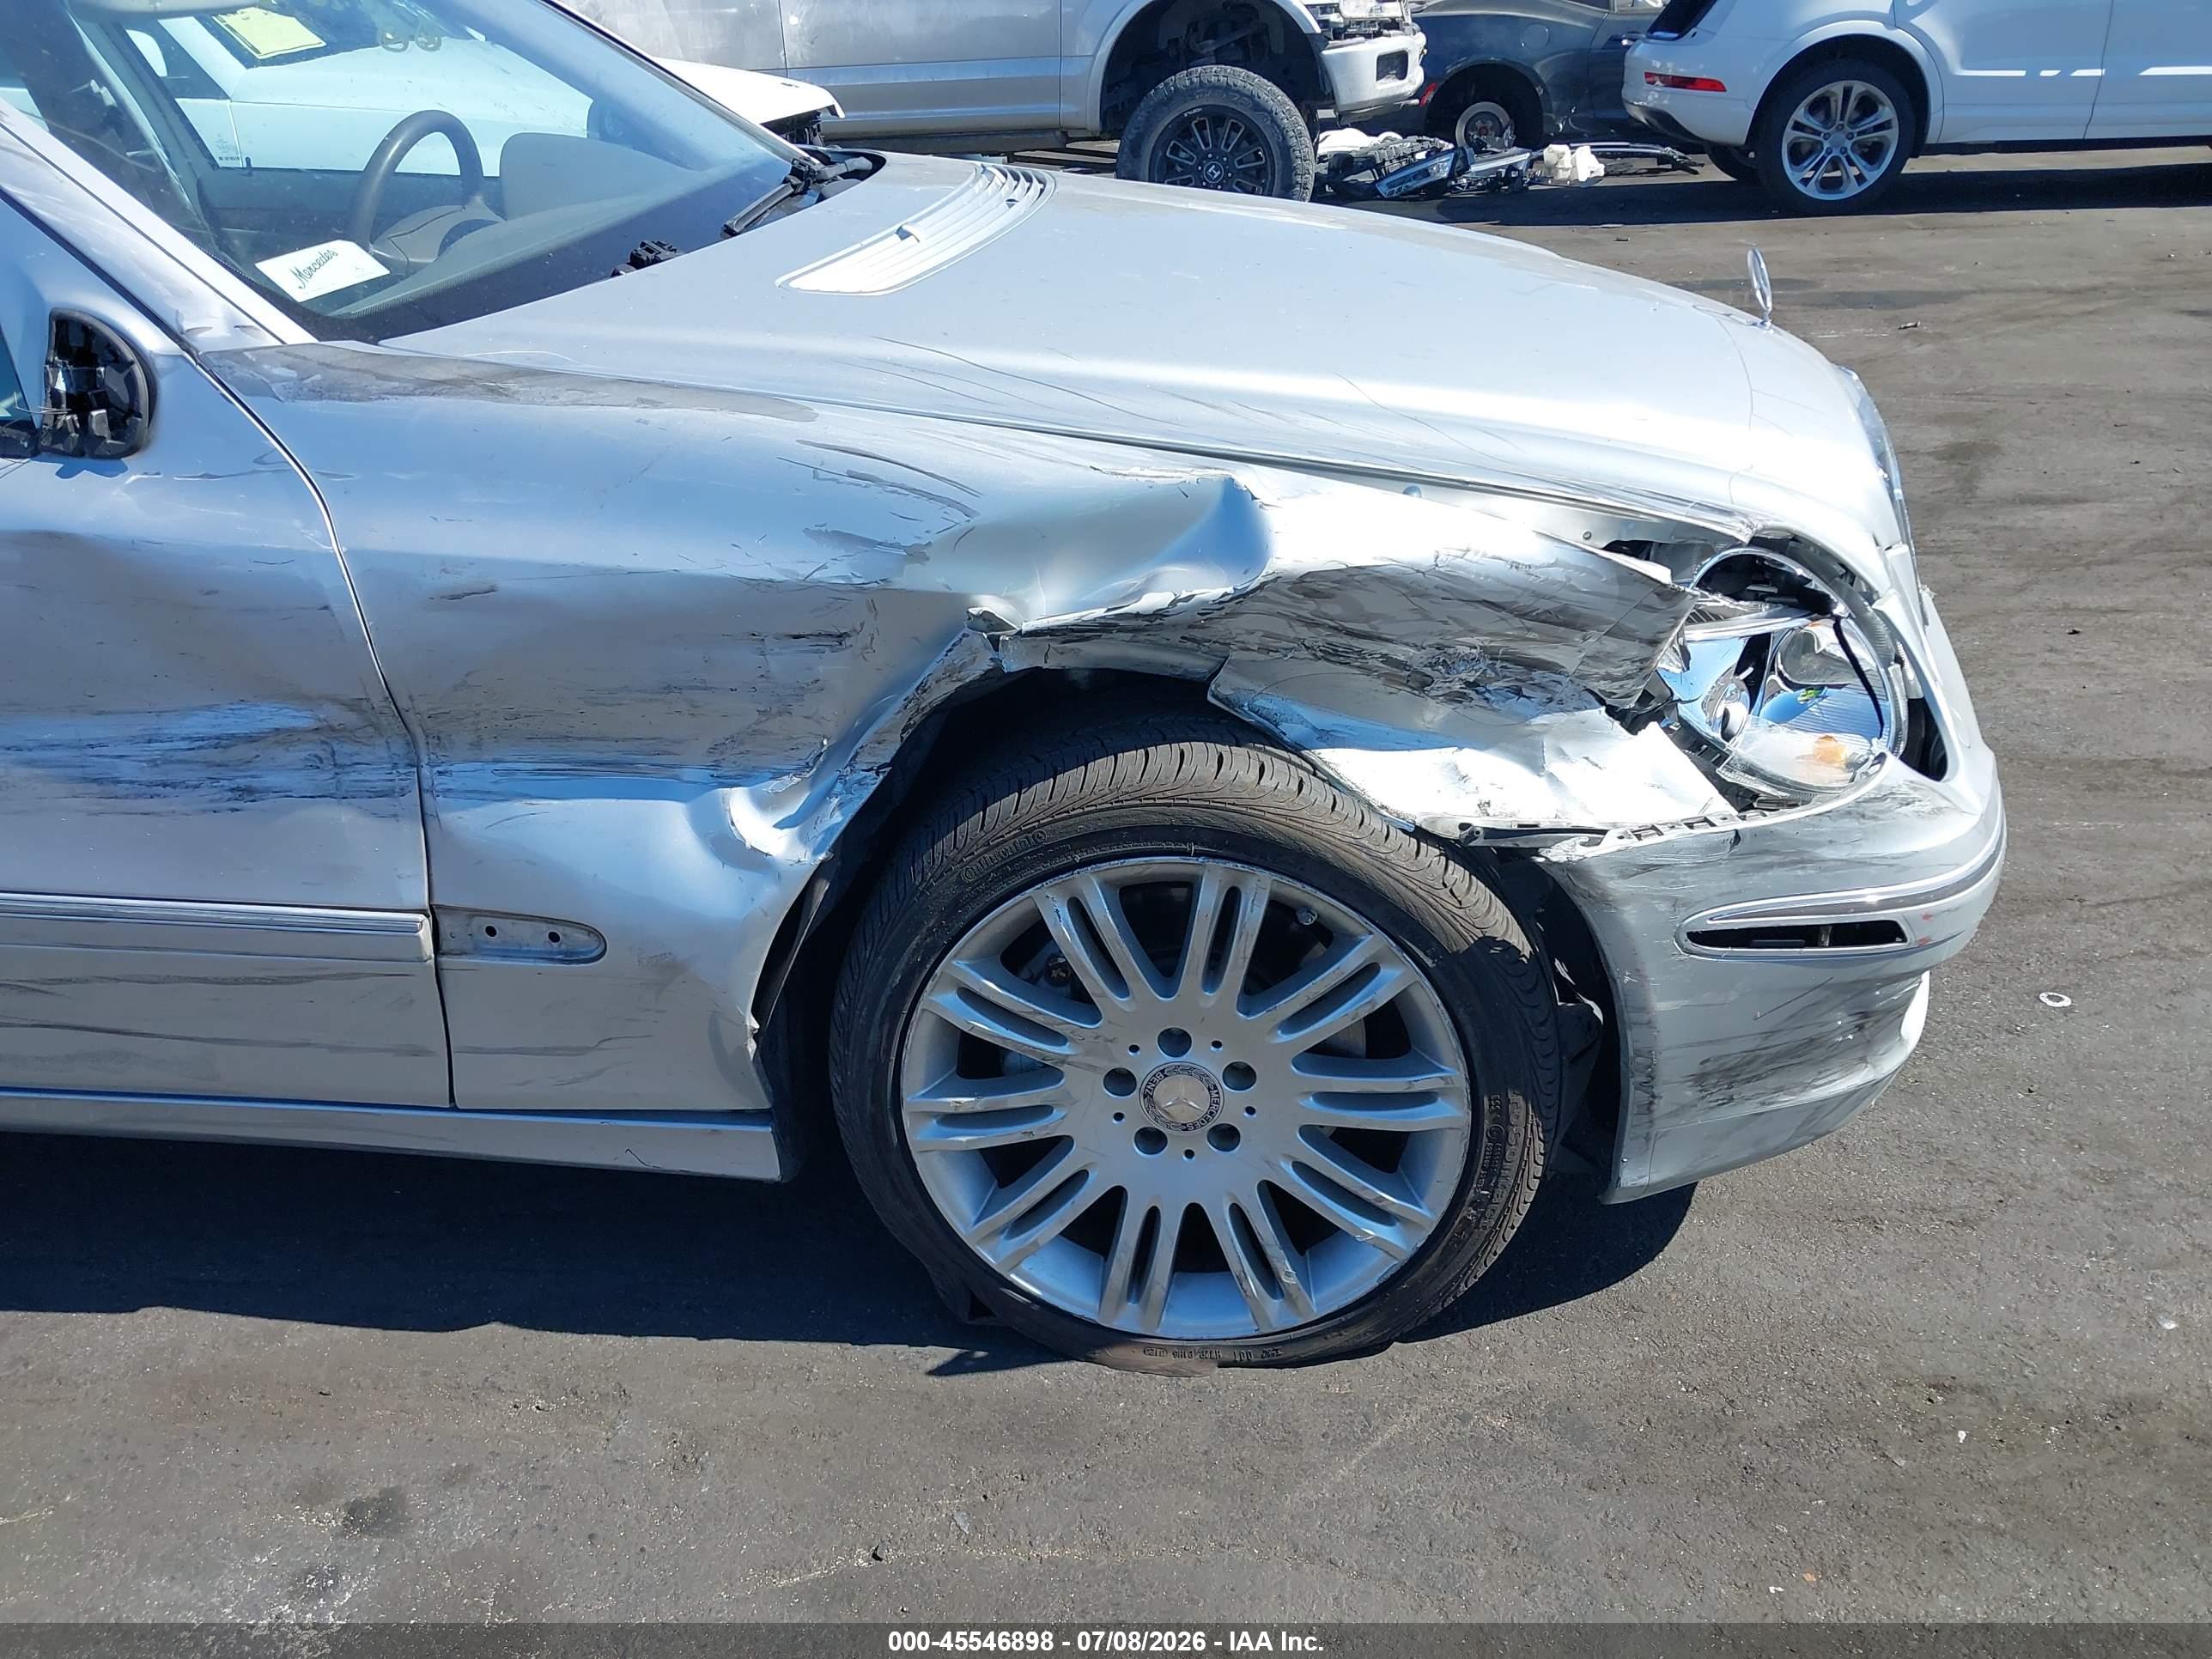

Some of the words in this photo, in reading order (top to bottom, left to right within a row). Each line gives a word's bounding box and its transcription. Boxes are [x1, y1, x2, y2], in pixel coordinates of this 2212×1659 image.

[289, 248, 339, 289] Mercedes
[1145, 1071, 1164, 1097] BENZ
[1186, 1088, 1220, 1131] MERCEDES
